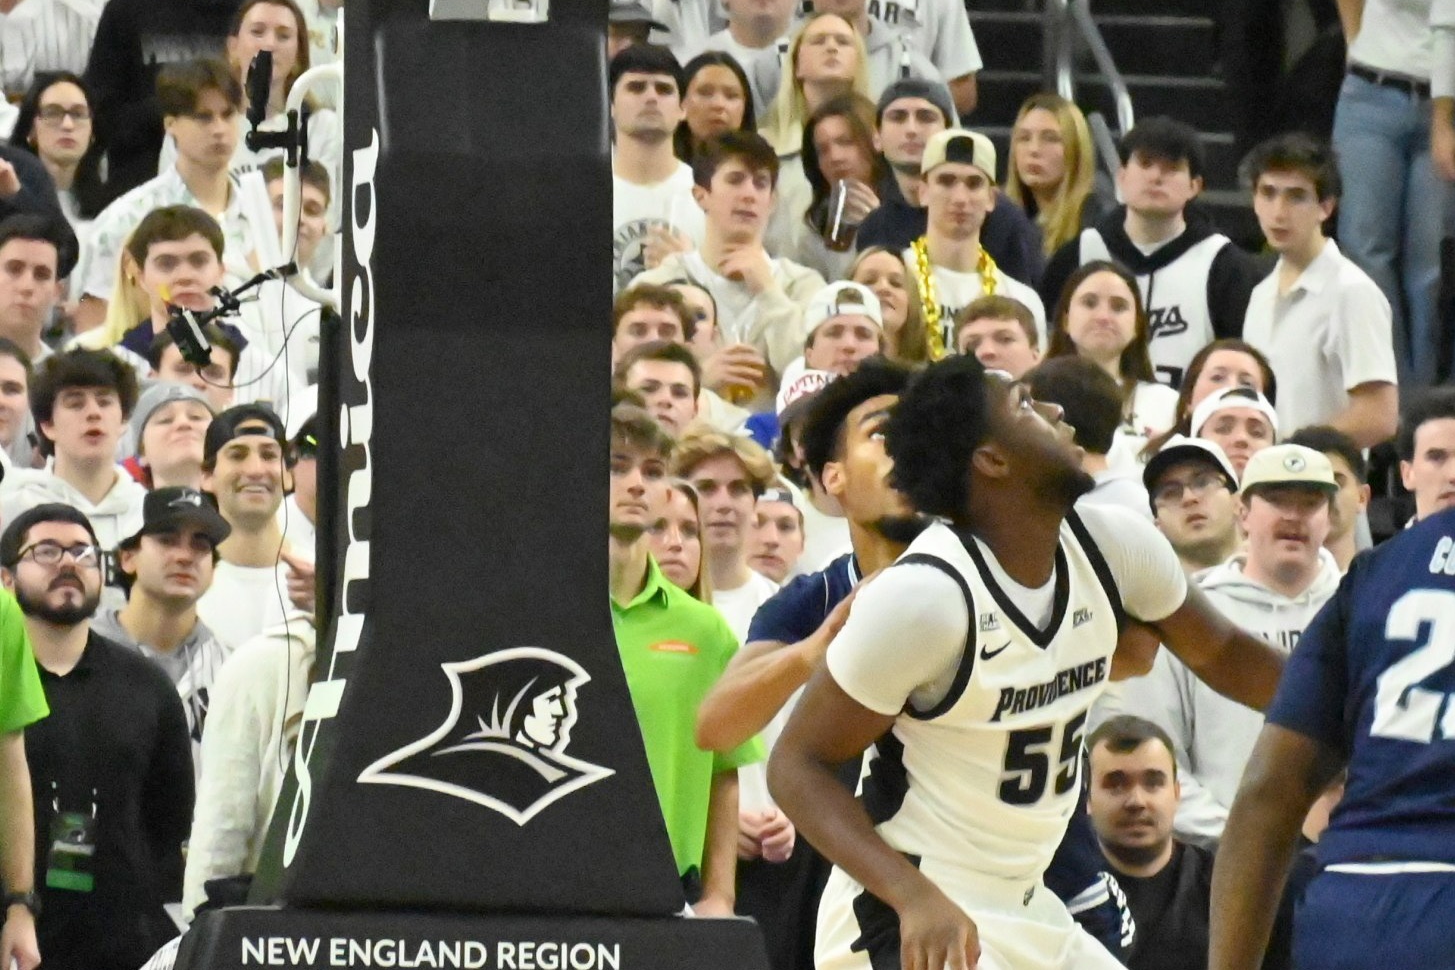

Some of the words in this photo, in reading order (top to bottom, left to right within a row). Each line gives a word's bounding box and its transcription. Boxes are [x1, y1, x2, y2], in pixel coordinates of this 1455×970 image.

[1000, 709, 1088, 806] 55
[241, 936, 321, 965] NEW
[329, 937, 488, 969] ENGLAND
[496, 941, 621, 970] REGION
